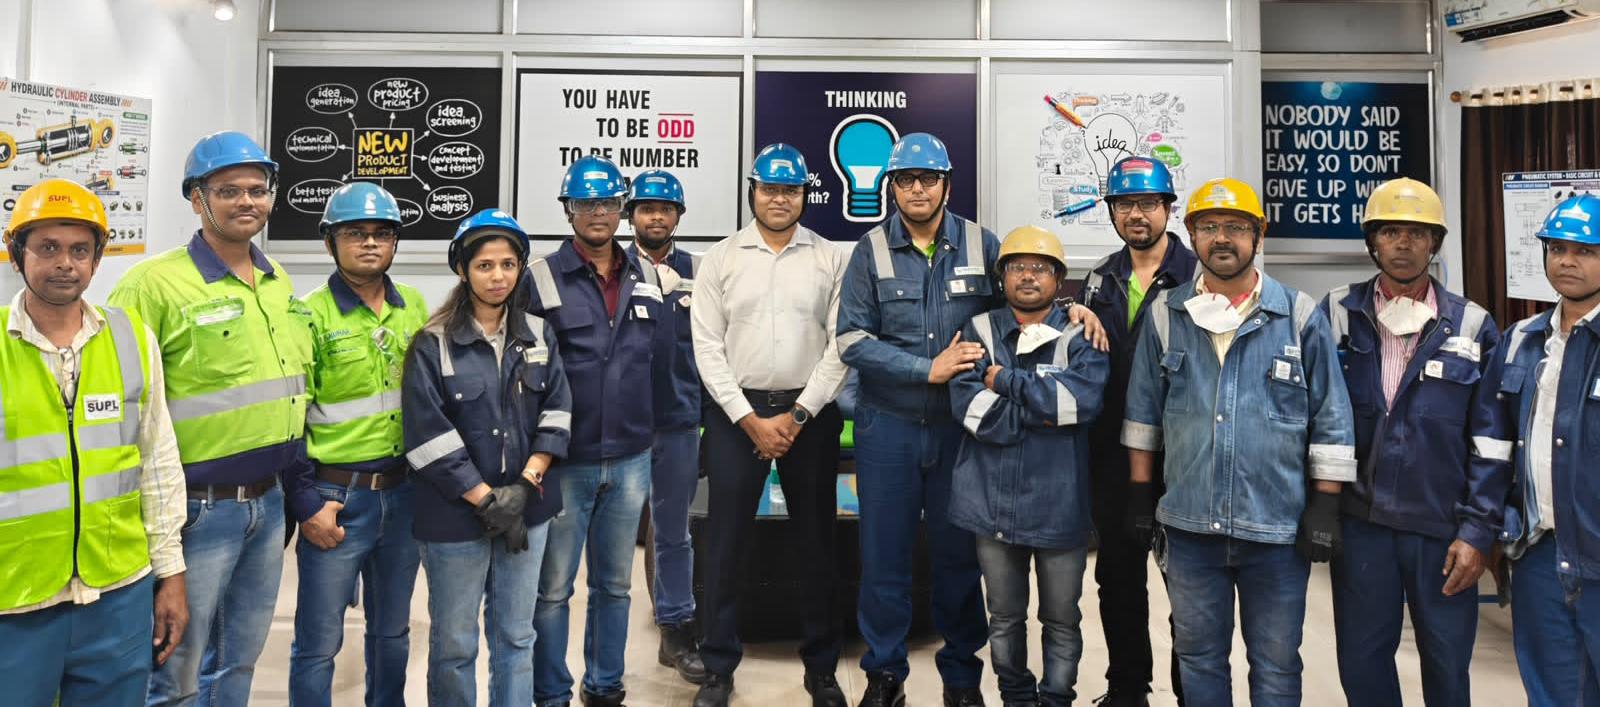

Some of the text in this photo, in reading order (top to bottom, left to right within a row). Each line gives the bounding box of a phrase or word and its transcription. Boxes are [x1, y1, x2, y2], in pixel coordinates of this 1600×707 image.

[387, 80, 408, 88] new
[11, 82, 121, 108] HYDRAULIC CYLINDER ASSEMBLY
[318, 87, 341, 98] idea
[373, 86, 421, 103] product
[562, 88, 650, 109] YOU HAVE
[825, 90, 907, 108] THINKING
[310, 95, 355, 108] generation
[383, 99, 410, 109] pricing
[438, 105, 464, 117] idea
[1265, 105, 1400, 127] NOBODY SAID
[430, 115, 477, 128] screening
[596, 118, 695, 138] TO BE ODD
[292, 133, 332, 146] technical
[358, 130, 408, 155] NEW
[1093, 128, 1128, 152] idea
[1265, 129, 1400, 150] IT WOULD BE
[439, 145, 470, 156] concept
[430, 154, 482, 165] development
[559, 147, 582, 166] TO
[620, 148, 699, 168] NUMBER
[1266, 153, 1401, 174] EASY, SO DON'T
[435, 164, 476, 174] and testing
[295, 186, 315, 197] beta
[1266, 178, 1308, 198] GIVE
[1317, 179, 1347, 198] UP
[48, 194, 73, 203] SUPL
[432, 193, 467, 202] business
[430, 201, 469, 214] analysis
[1265, 203, 1284, 223] IT
[1294, 203, 1341, 224] GETS
[87, 400, 120, 413] SUPL
